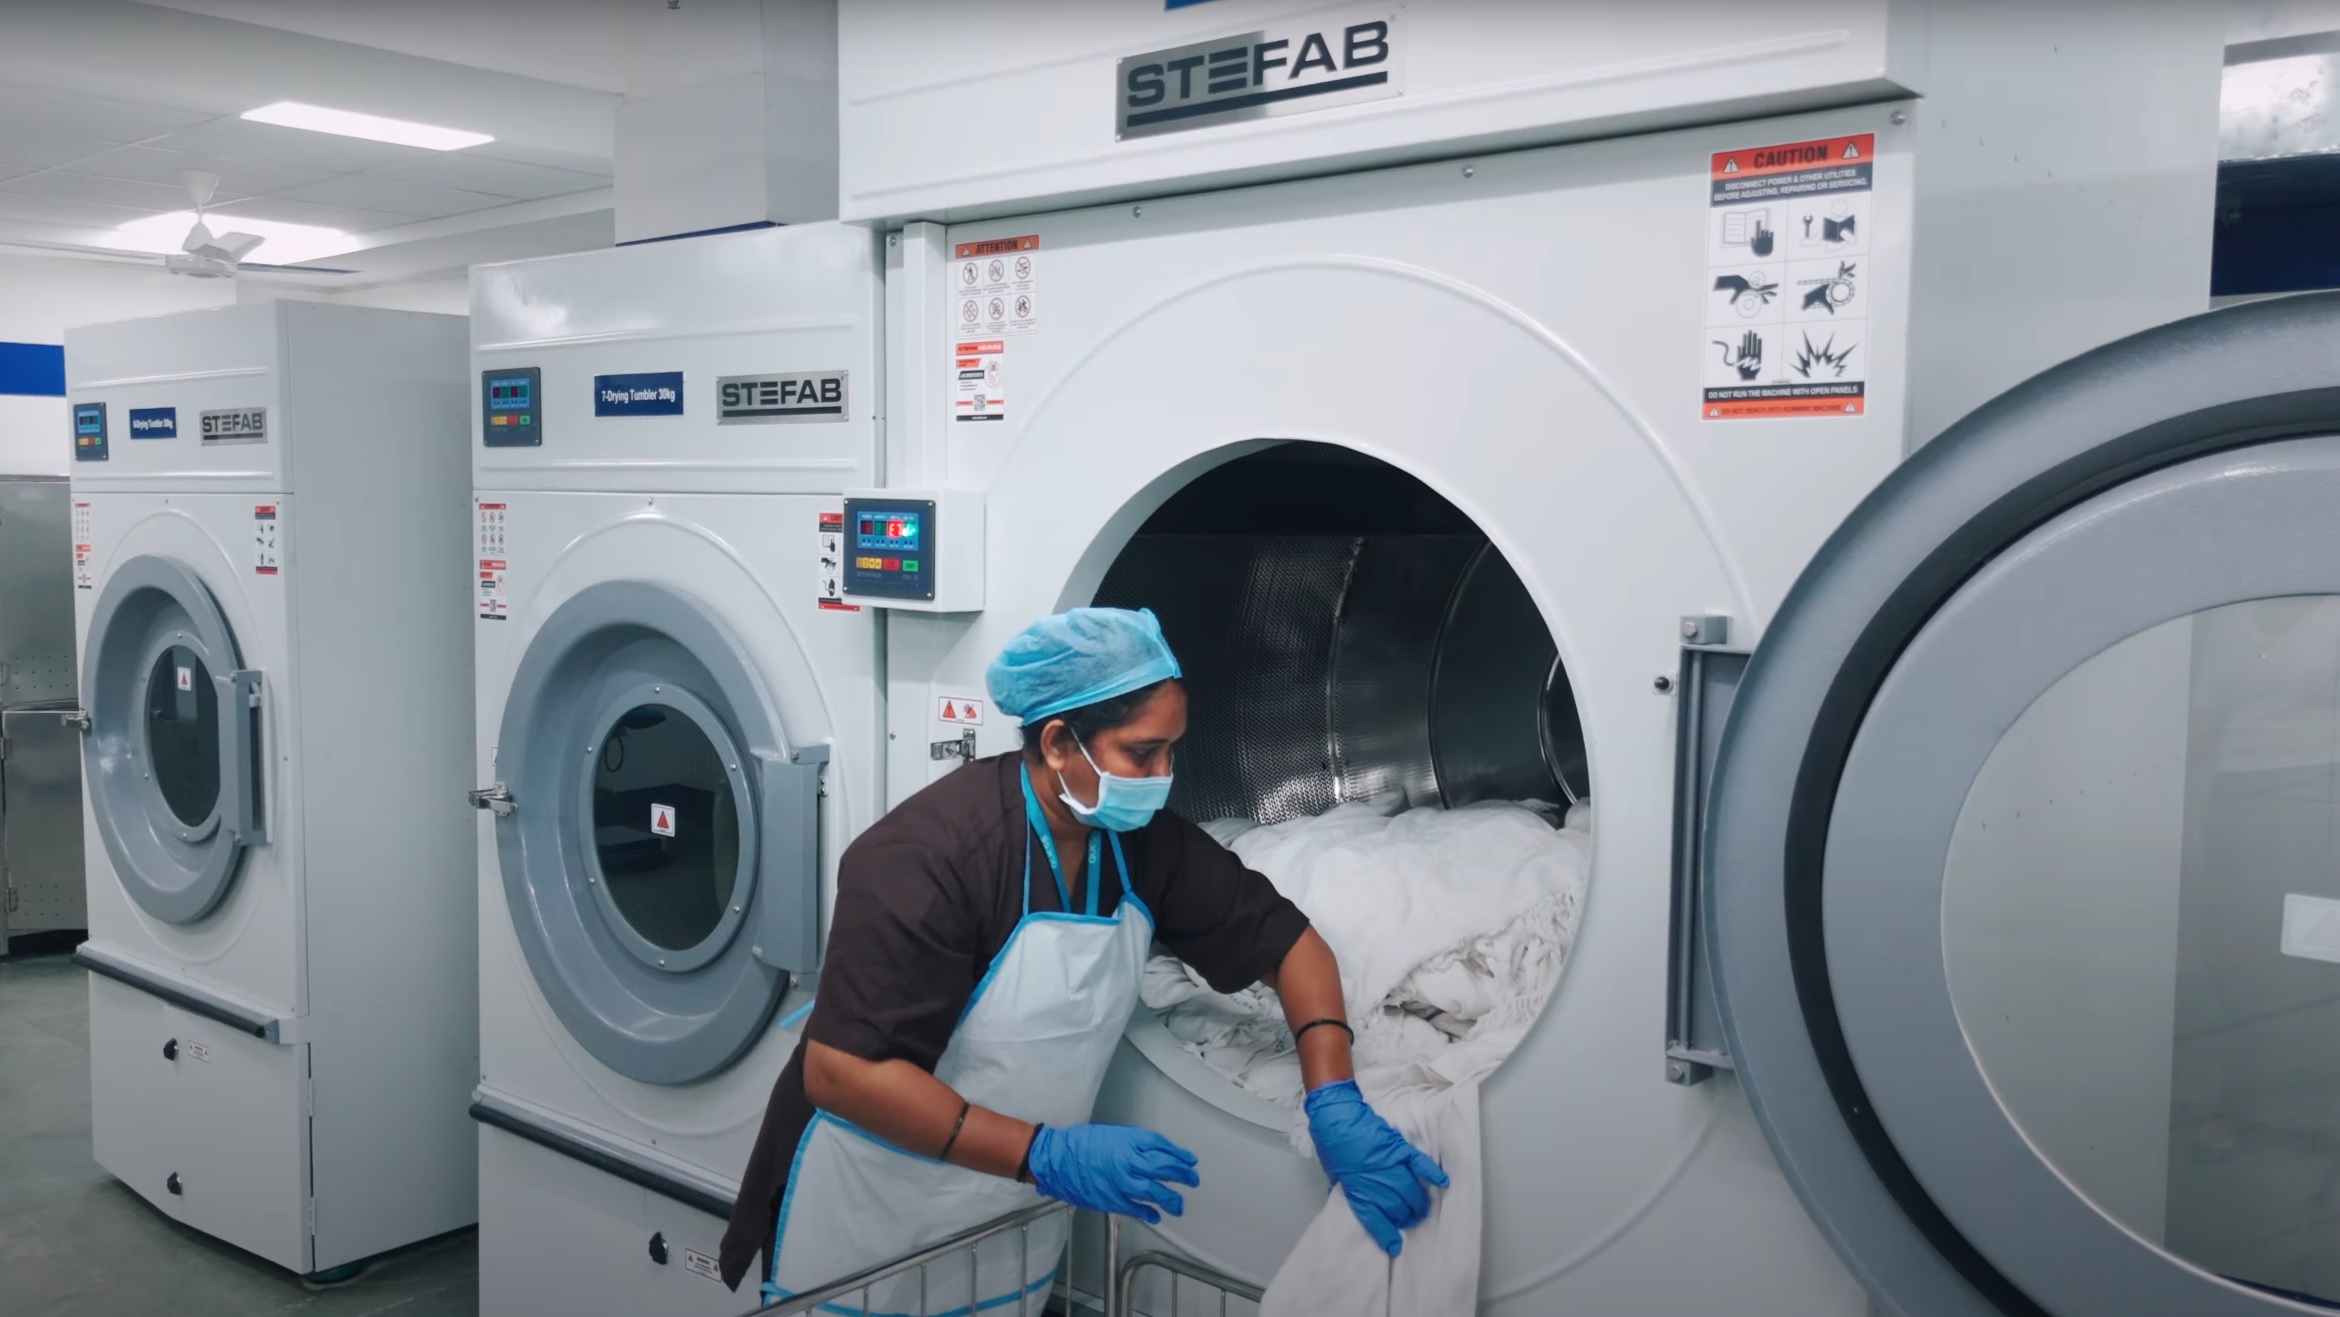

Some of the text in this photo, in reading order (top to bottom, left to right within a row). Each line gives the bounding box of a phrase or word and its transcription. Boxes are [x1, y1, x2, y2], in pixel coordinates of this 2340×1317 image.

[1127, 20, 1389, 108] STEFAB
[1754, 146, 1828, 168] CAUTION
[1725, 169, 1856, 191] DISCONNECT POWER & OTHER UTILITIES
[1714, 191, 1740, 201] BEFORE
[1780, 183, 1816, 194] REPAIRING
[1817, 181, 1827, 190] OR
[975, 240, 1018, 255] ATTENTION
[601, 387, 676, 404] 7-Drying Tumbler 30kg
[722, 378, 842, 407] STEFAB
[1708, 385, 1858, 399] DO NOT RUN THE MACHINE WITH OPEN PANELS
[202, 413, 263, 433] STEFAB
